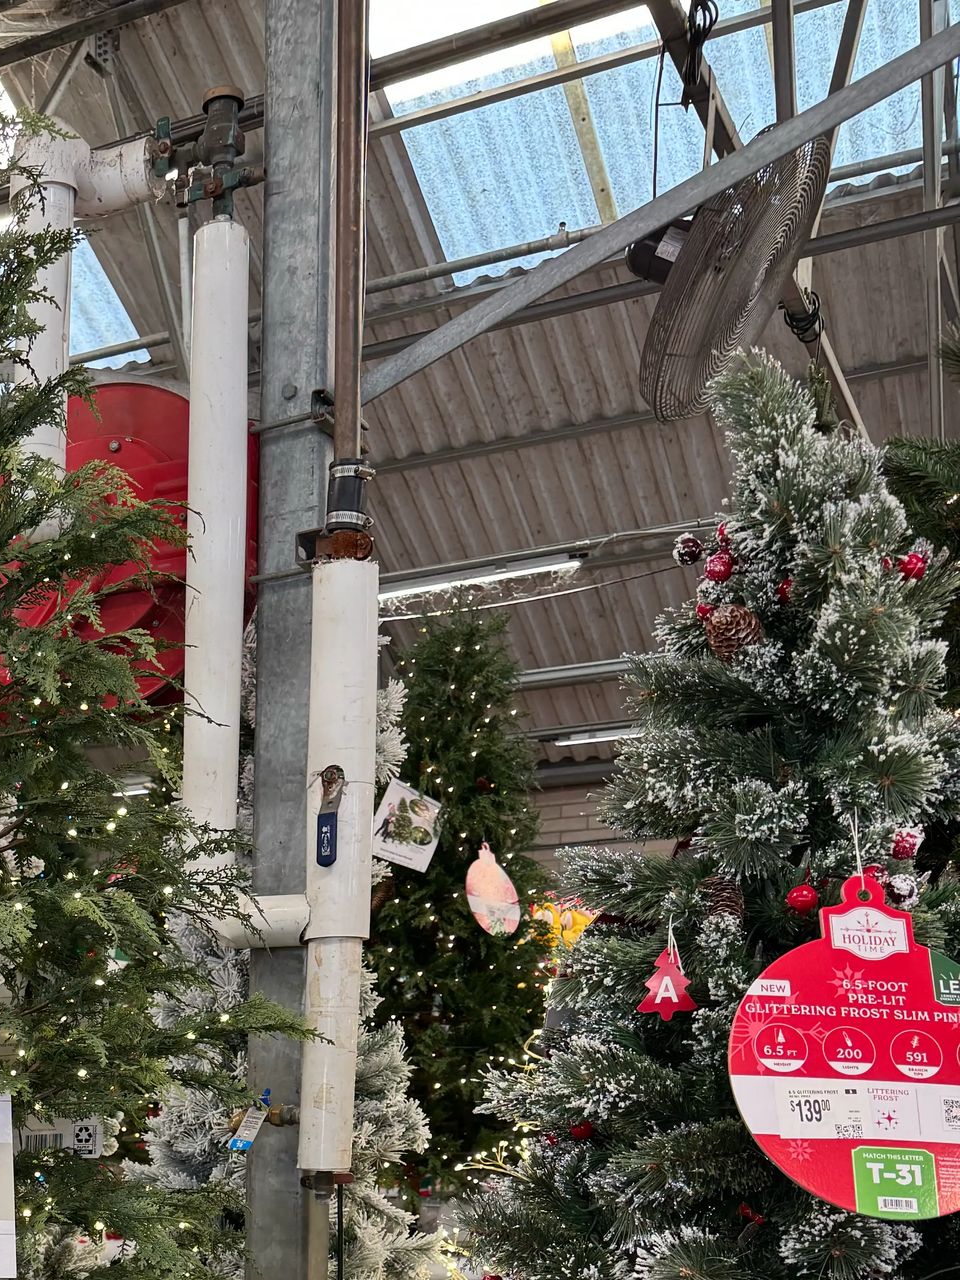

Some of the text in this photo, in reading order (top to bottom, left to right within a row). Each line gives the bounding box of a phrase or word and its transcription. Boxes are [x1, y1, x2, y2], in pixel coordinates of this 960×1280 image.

[842, 934, 896, 946] HOLIDAY
[858, 945, 884, 953] TIME
[654, 976, 679, 1004] A
[760, 984, 787, 992] NEW
[842, 980, 908, 992] 6.5-FOOT
[940, 980, 960, 994] LE
[848, 994, 906, 1006] PRE-LIT
[745, 1003, 960, 1023] GLITTERING FROST SLIM PIN
[764, 1046, 784, 1056] 6.5
[836, 1049, 862, 1059] 200
[906, 1052, 928, 1062] 591
[866, 1162, 922, 1186] T-31
